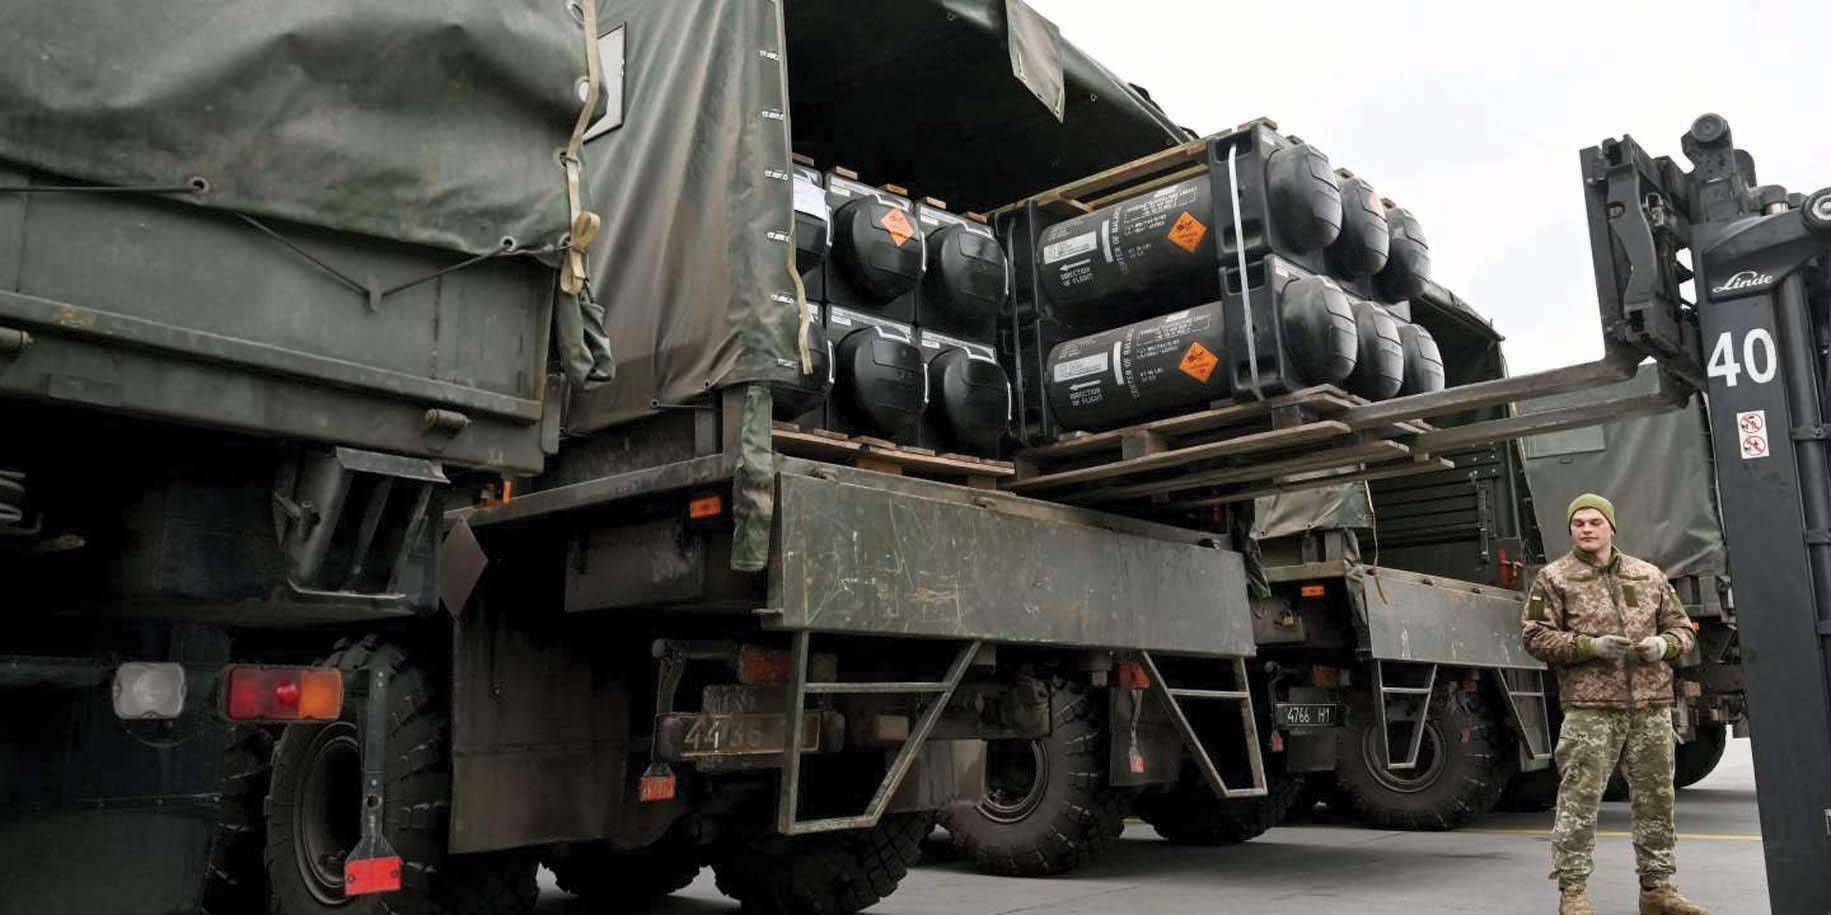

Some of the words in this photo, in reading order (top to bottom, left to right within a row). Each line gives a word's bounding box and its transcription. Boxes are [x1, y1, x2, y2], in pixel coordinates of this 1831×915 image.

[1712, 271, 1774, 293] Linde
[1707, 328, 1777, 387] 40
[1287, 706, 1311, 723] 4766
